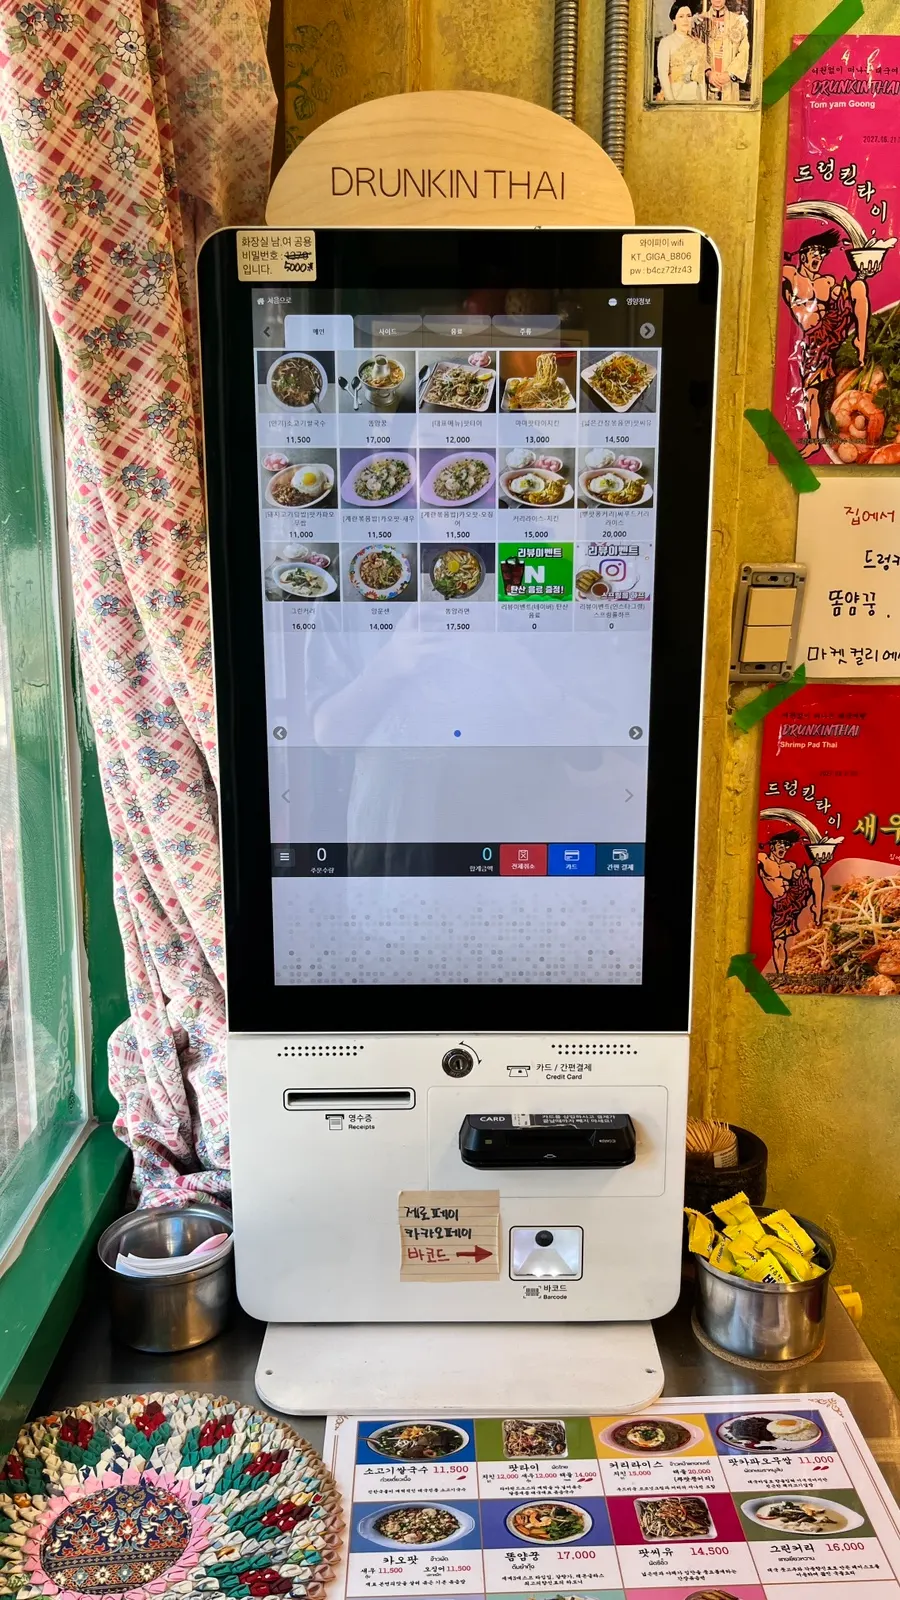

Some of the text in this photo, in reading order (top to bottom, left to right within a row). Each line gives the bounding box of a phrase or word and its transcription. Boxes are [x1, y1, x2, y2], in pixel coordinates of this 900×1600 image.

[829, 101, 846, 110] yam
[848, 100, 876, 109] Goong
[484, 170, 564, 200] THAI
[242, 236, 312, 248] 화장실 남.여 공용
[639, 238, 669, 247] 와이파이
[242, 250, 278, 261] 비밀번호
[631, 252, 692, 262] KT_GIGA_B806
[242, 264, 272, 275] 입니다.
[378, 327, 397, 335] 사이드
[519, 328, 532, 336] 주류
[286, 436, 311, 444] 11,500
[366, 436, 390, 444] 17,000
[843, 506, 895, 526] 집에서
[518, 548, 562, 558] 리뷰이벤트
[807, 646, 900, 666] 마켓컬리에
[317, 848, 327, 861] 0
[482, 847, 492, 861] 0
[536, 1063, 553, 1072] 카드
[560, 1063, 592, 1072] 간편결제
[348, 1114, 372, 1122] 영수증
[404, 1227, 472, 1240] 카카오페이
[408, 1247, 450, 1263] 바코드
[543, 1284, 567, 1292] 바코드
[609, 1460, 663, 1470] 커리라이스
[363, 1466, 428, 1475] 소고기쌀국수
[770, 1543, 815, 1553] 그린커리
